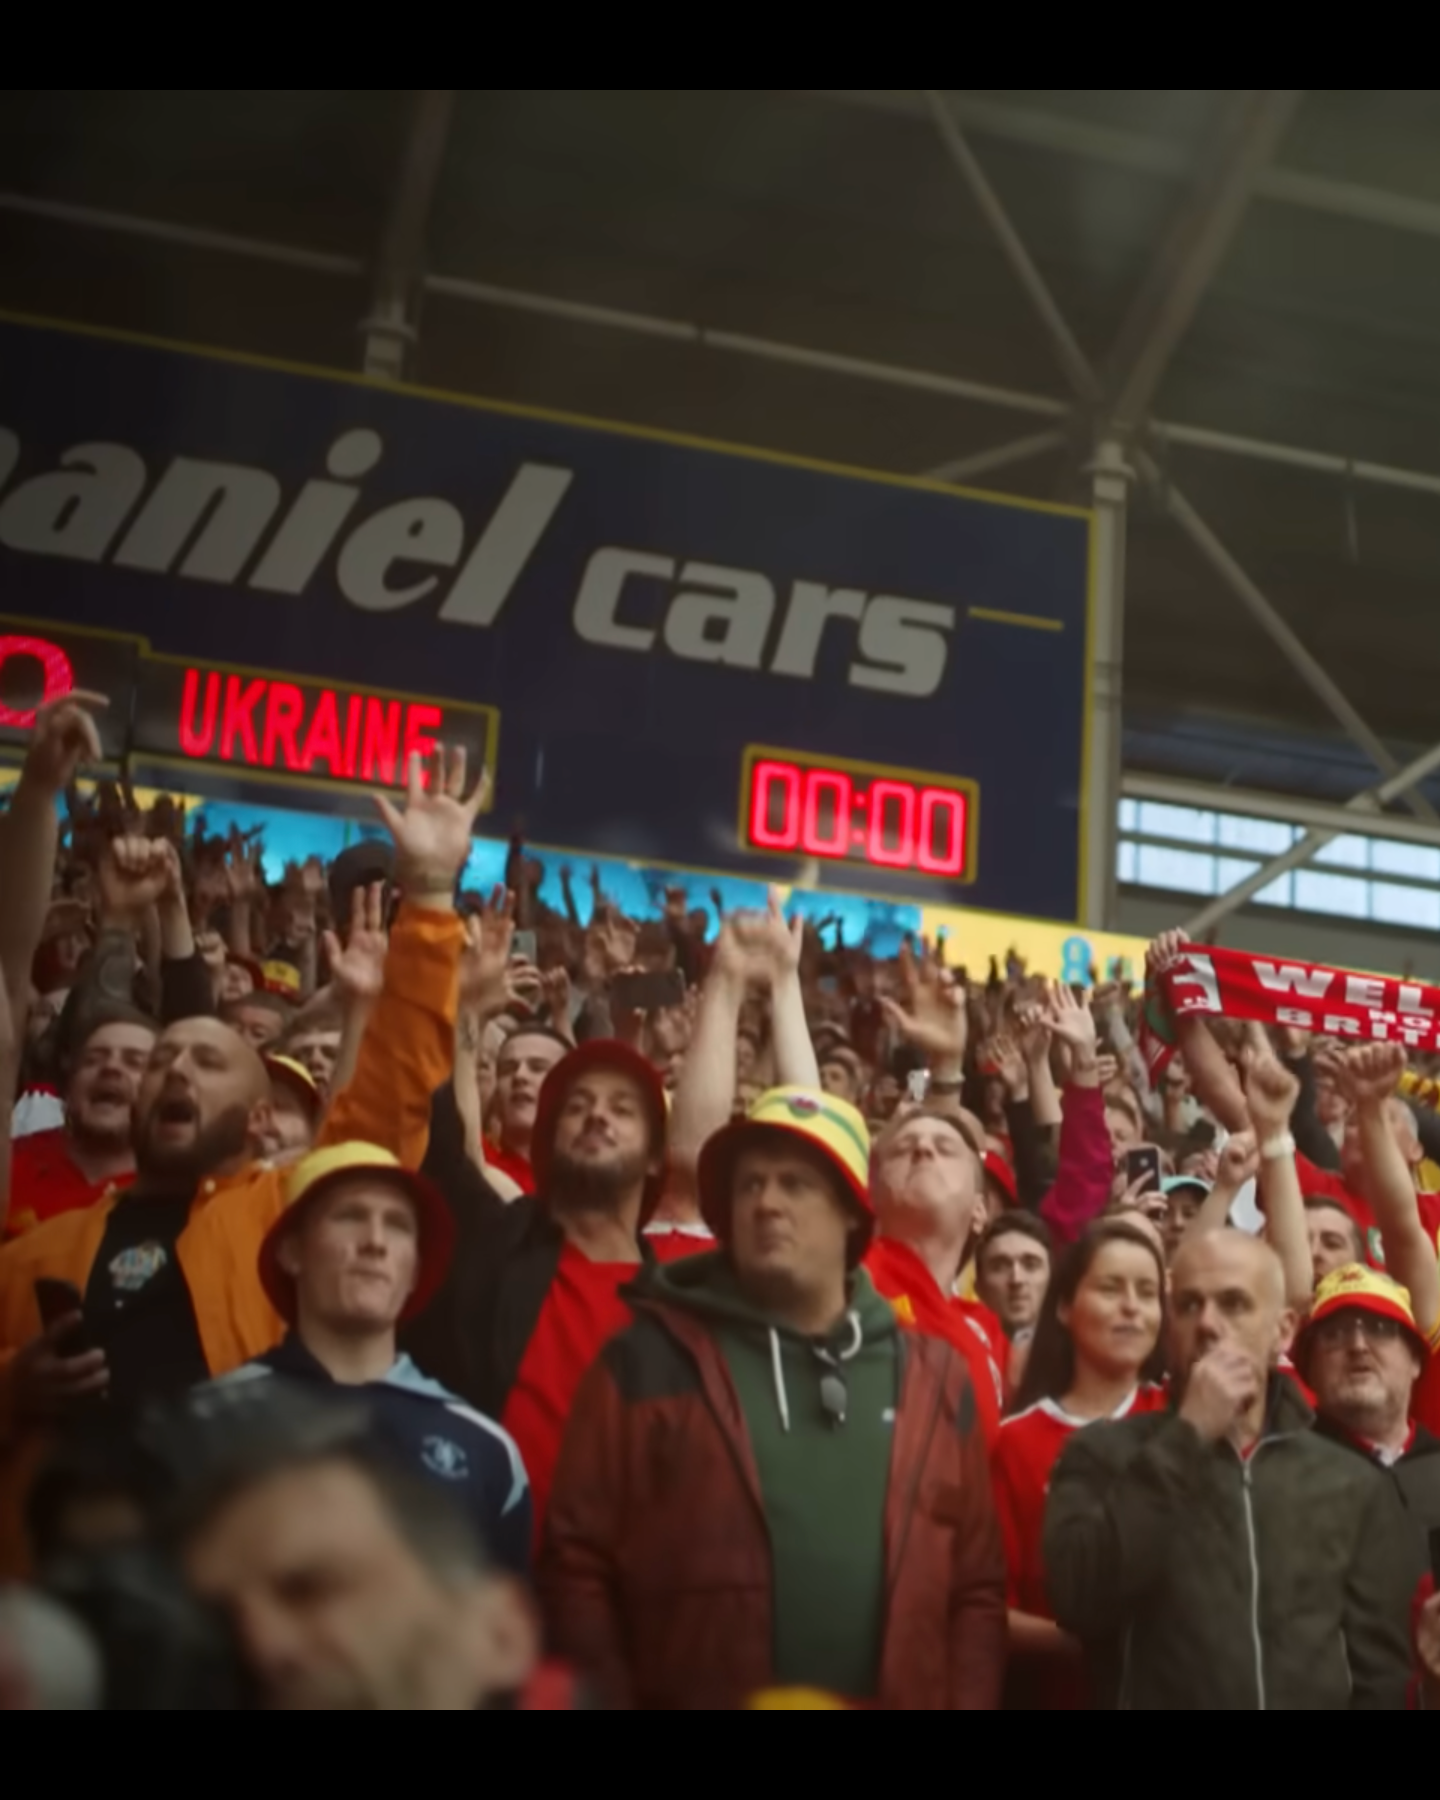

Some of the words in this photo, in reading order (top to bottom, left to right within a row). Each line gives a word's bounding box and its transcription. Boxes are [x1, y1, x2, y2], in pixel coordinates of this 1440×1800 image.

[0, 426, 573, 627] aniel
[573, 547, 956, 698] cars
[178, 668, 443, 790] UKRAINE
[749, 759, 968, 878] 00:00
